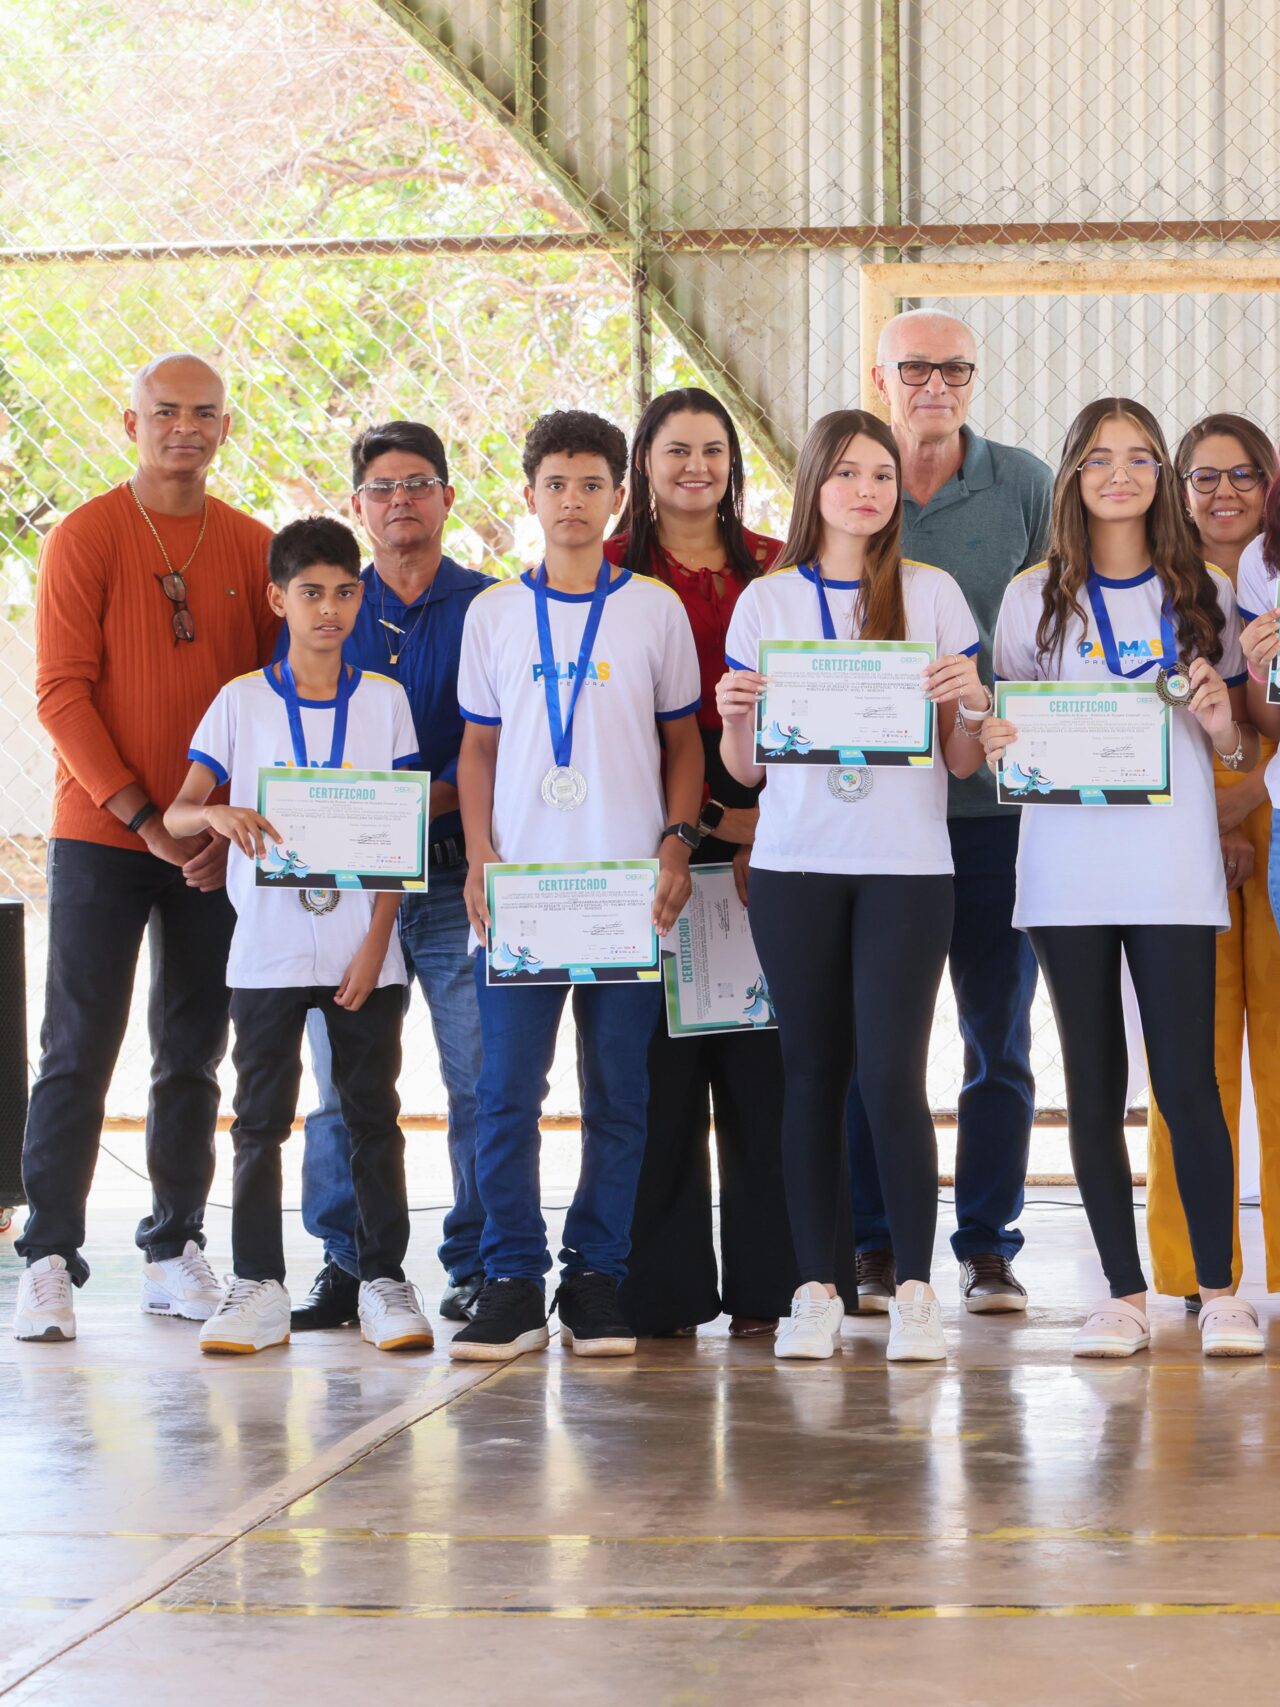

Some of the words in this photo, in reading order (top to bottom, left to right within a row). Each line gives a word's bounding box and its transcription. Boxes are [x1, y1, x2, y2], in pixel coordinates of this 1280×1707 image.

[1080, 639, 1164, 658] PAMAS
[532, 661, 611, 681] PLAS
[812, 658, 882, 672] CERTIFICADO
[1049, 700, 1119, 713] CERTIFICADO
[308, 786, 376, 801] CERTIFICADO
[538, 878, 608, 892] CERTIFICADO
[677, 917, 694, 984] CERTIFICADO
